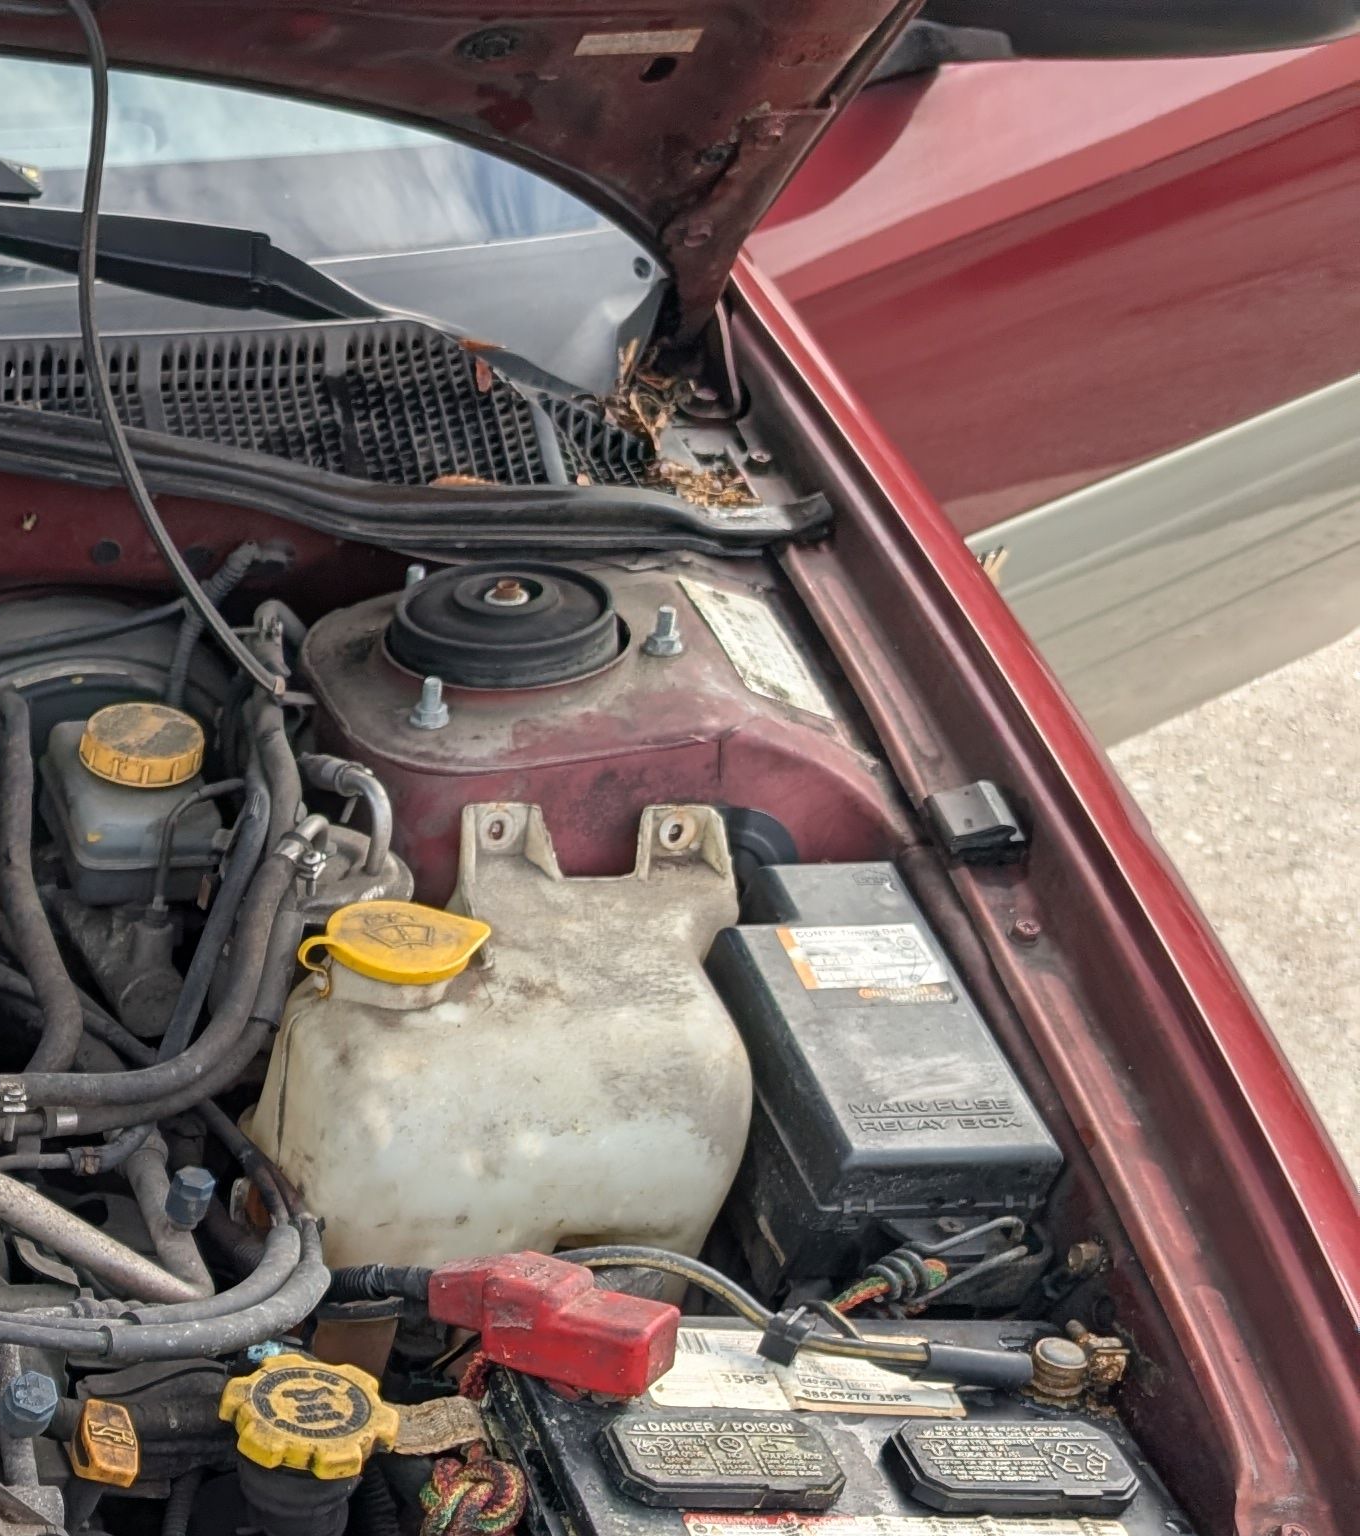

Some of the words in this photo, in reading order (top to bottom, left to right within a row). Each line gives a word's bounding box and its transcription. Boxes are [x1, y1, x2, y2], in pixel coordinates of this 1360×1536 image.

[847, 1100, 929, 1114] MAIN
[933, 1098, 1012, 1112] FUSE
[857, 1119, 948, 1132] RELAY
[957, 1117, 1023, 1130] BOX
[647, 1421, 715, 1432] DANGER
[733, 1422, 794, 1433] POISON
